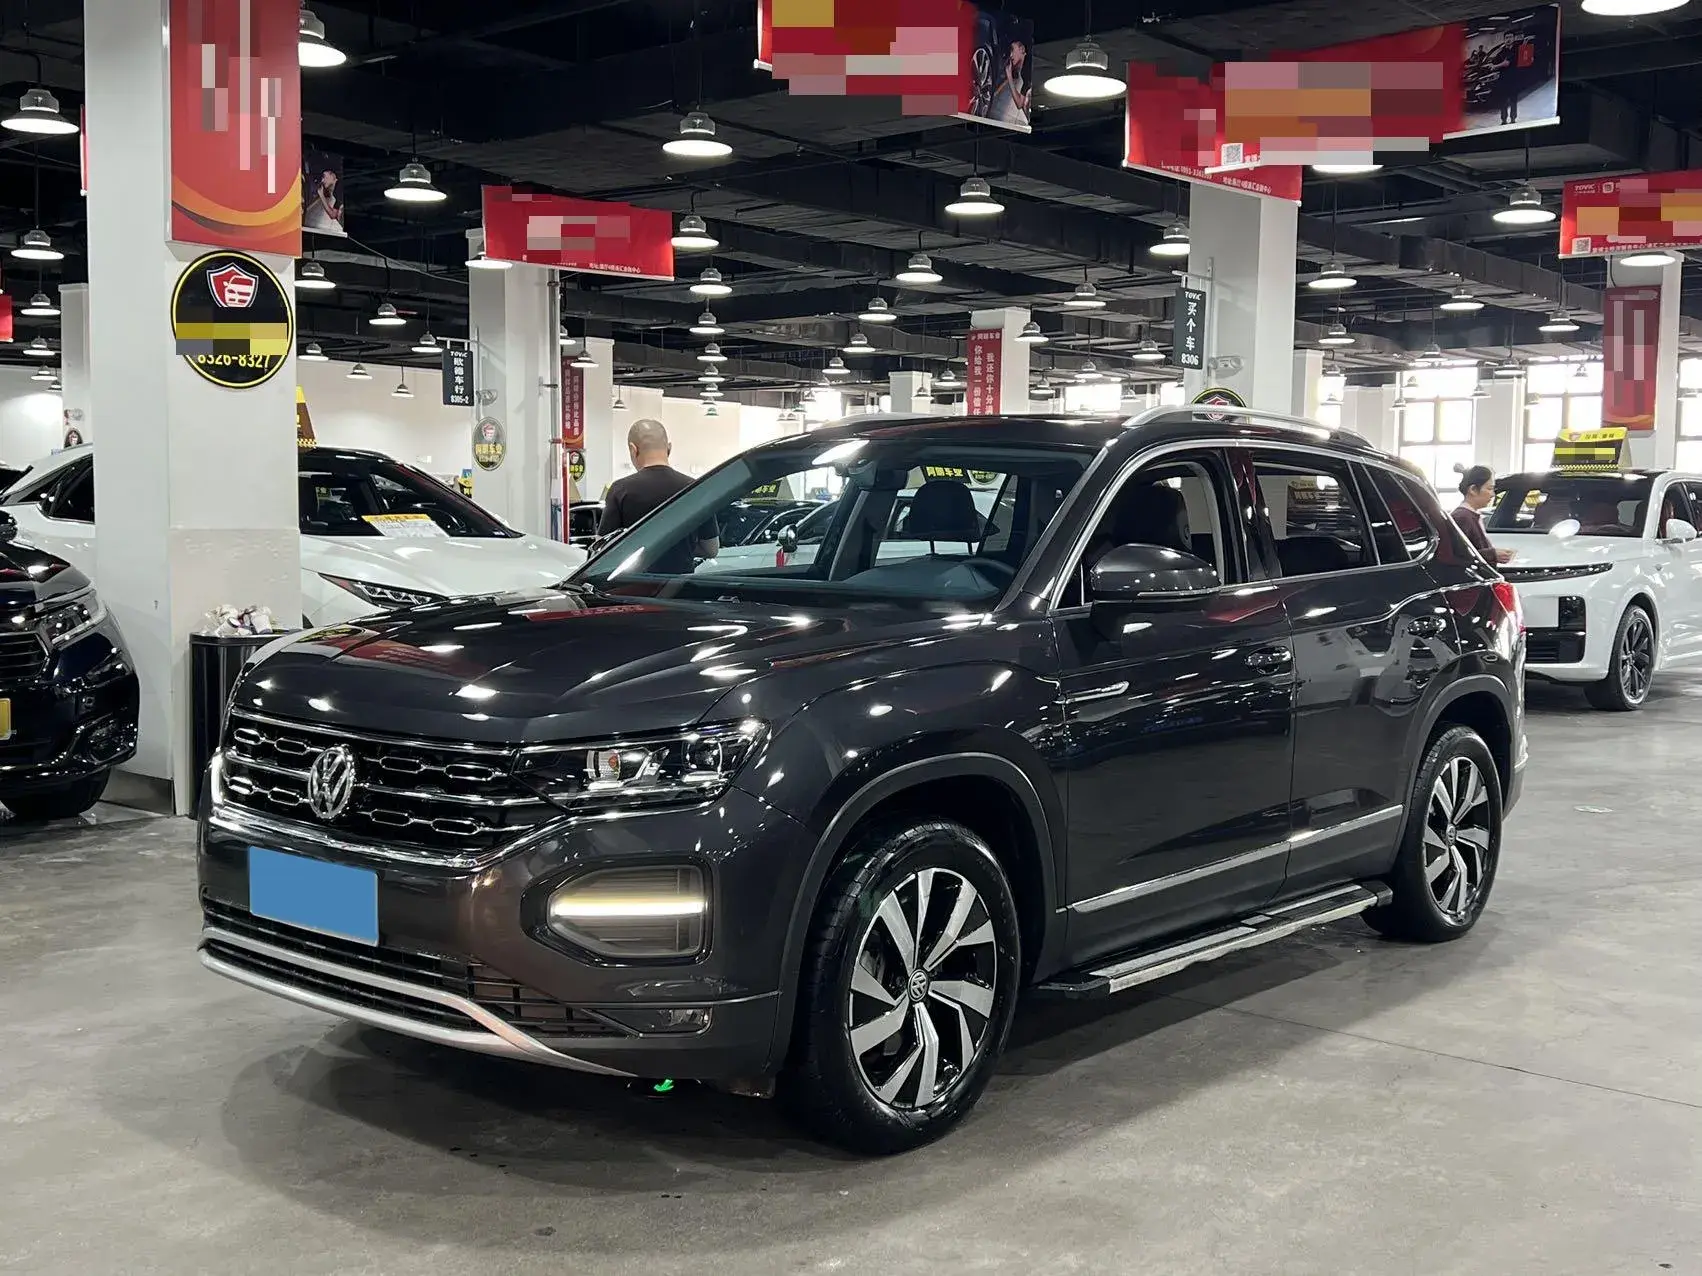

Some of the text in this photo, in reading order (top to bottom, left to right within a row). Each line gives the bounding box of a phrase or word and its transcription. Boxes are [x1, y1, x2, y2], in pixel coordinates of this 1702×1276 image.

[1186, 301, 1197, 351] 买个车
[1181, 352, 1200, 366] 8306
